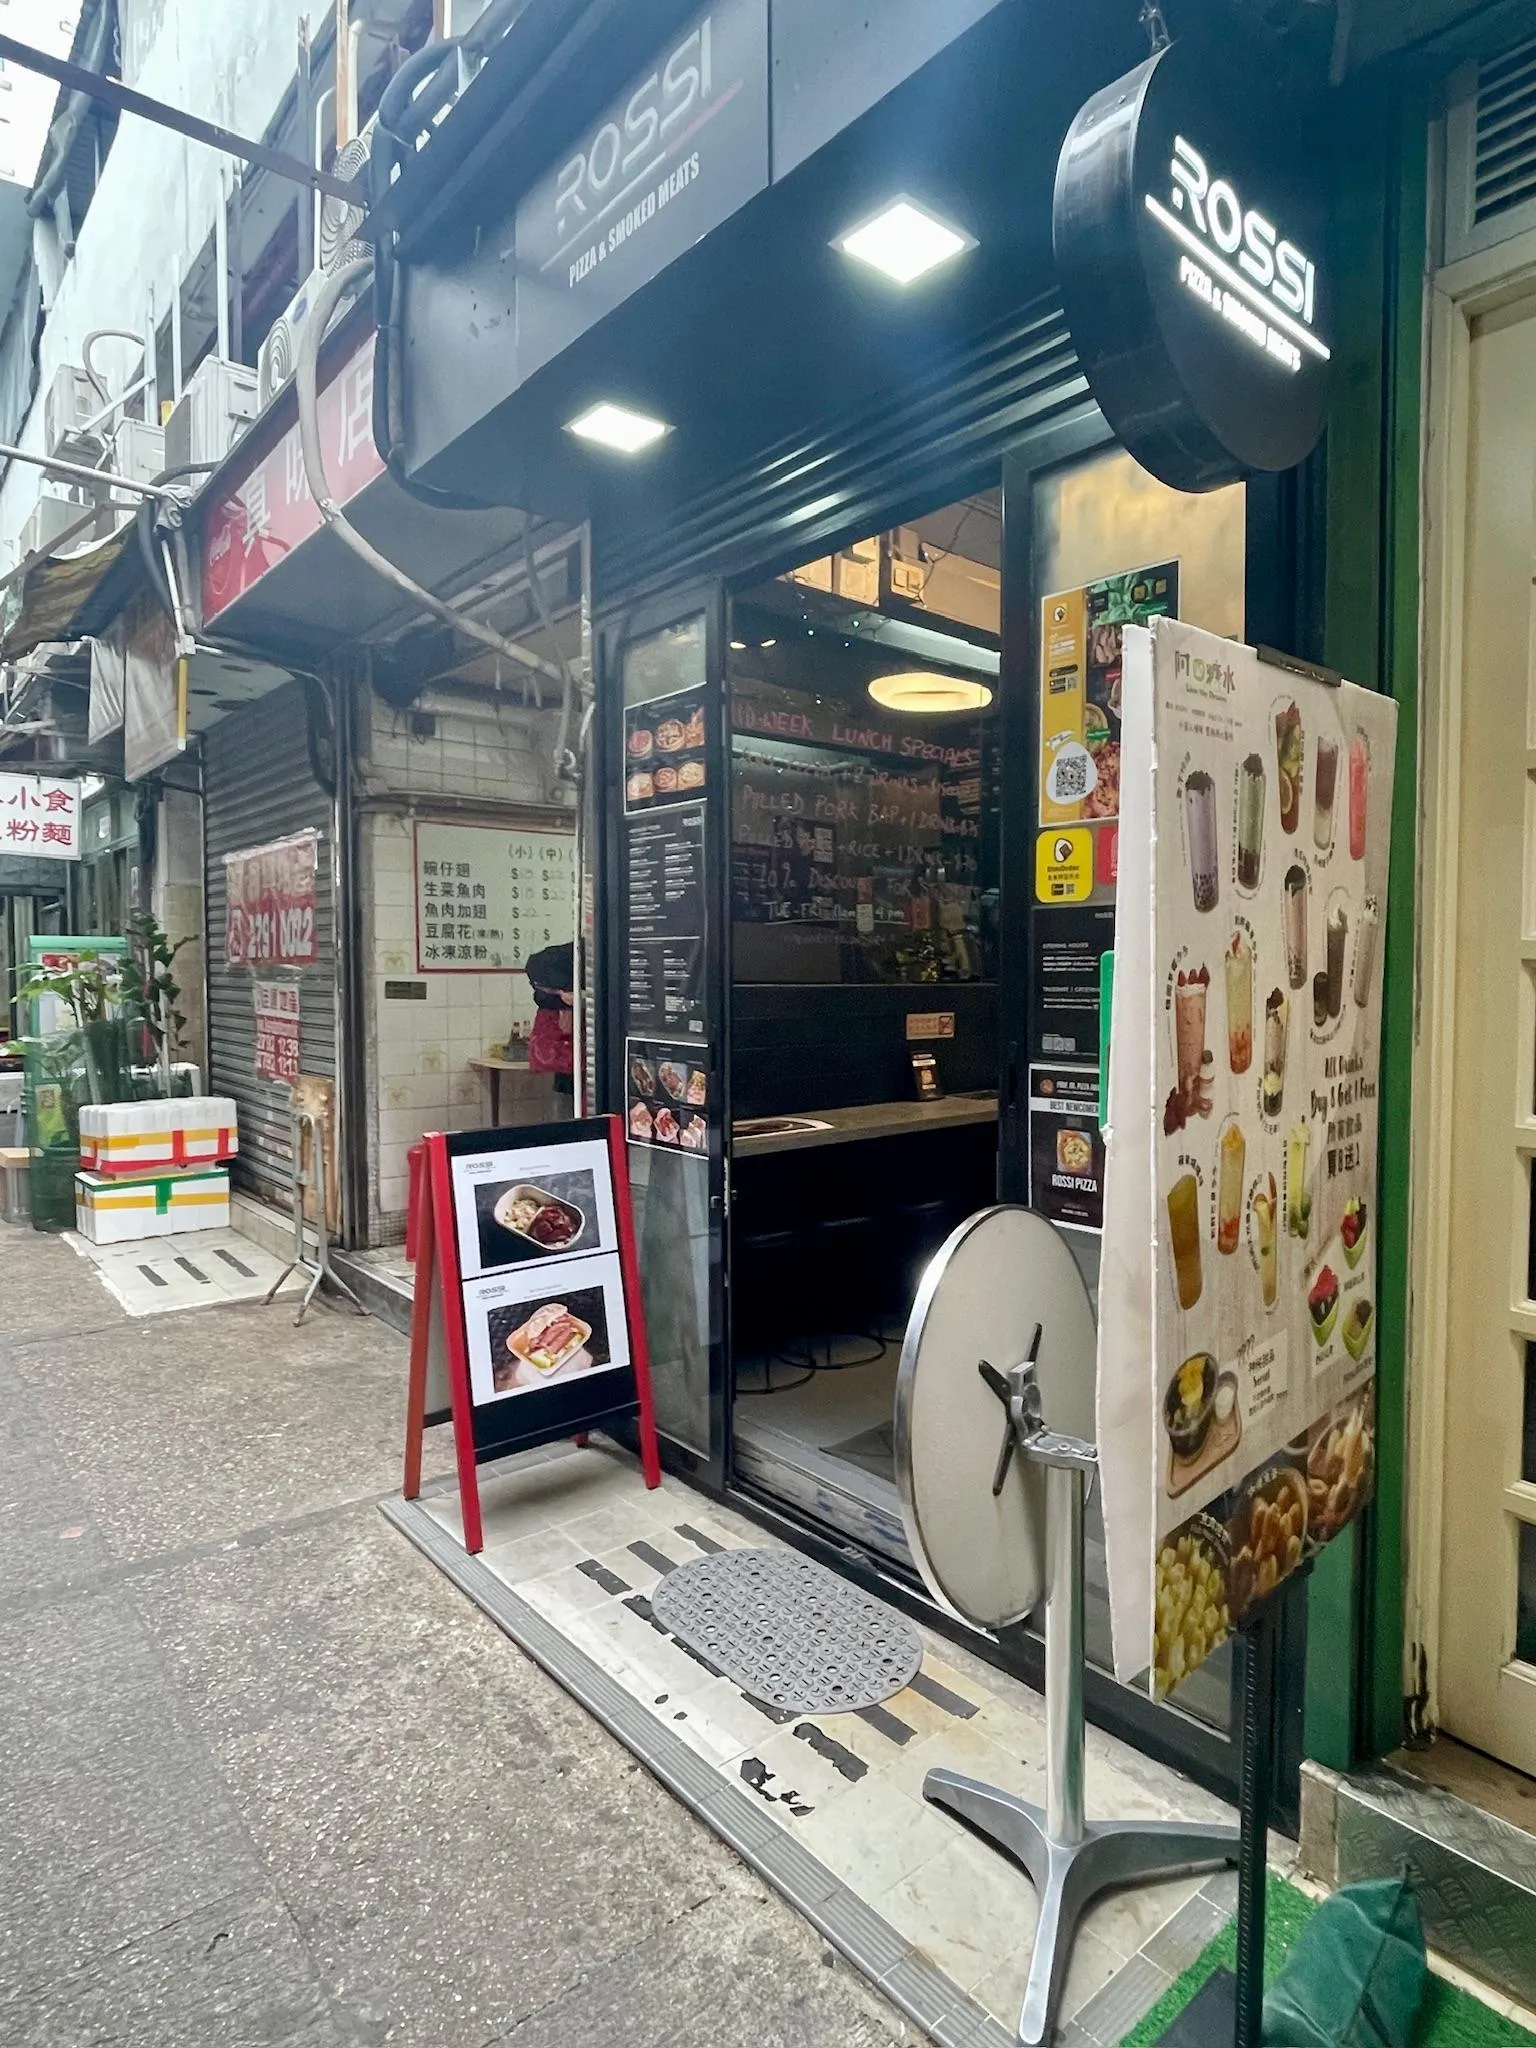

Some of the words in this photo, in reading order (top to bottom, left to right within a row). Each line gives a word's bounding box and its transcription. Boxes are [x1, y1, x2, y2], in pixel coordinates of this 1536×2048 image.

[554, 15, 713, 236] ROSSI
[568, 245, 598, 289] PIZZA
[607, 191, 656, 253] SMOKED
[657, 151, 700, 210] MEATS
[1170, 134, 1316, 325] ROSSI
[833, 726, 892, 752] LUNCH
[814, 794, 858, 821] PORK
[423, 860, 471, 878] 碗仔翅
[423, 881, 486, 900] 生菜魚肉
[424, 902, 487, 920] 魚肉加翅
[425, 944, 488, 960] 冰凍涼粉
[1051, 1173, 1075, 1189] ROSSI
[1074, 1177, 1098, 1193] PIZZA
